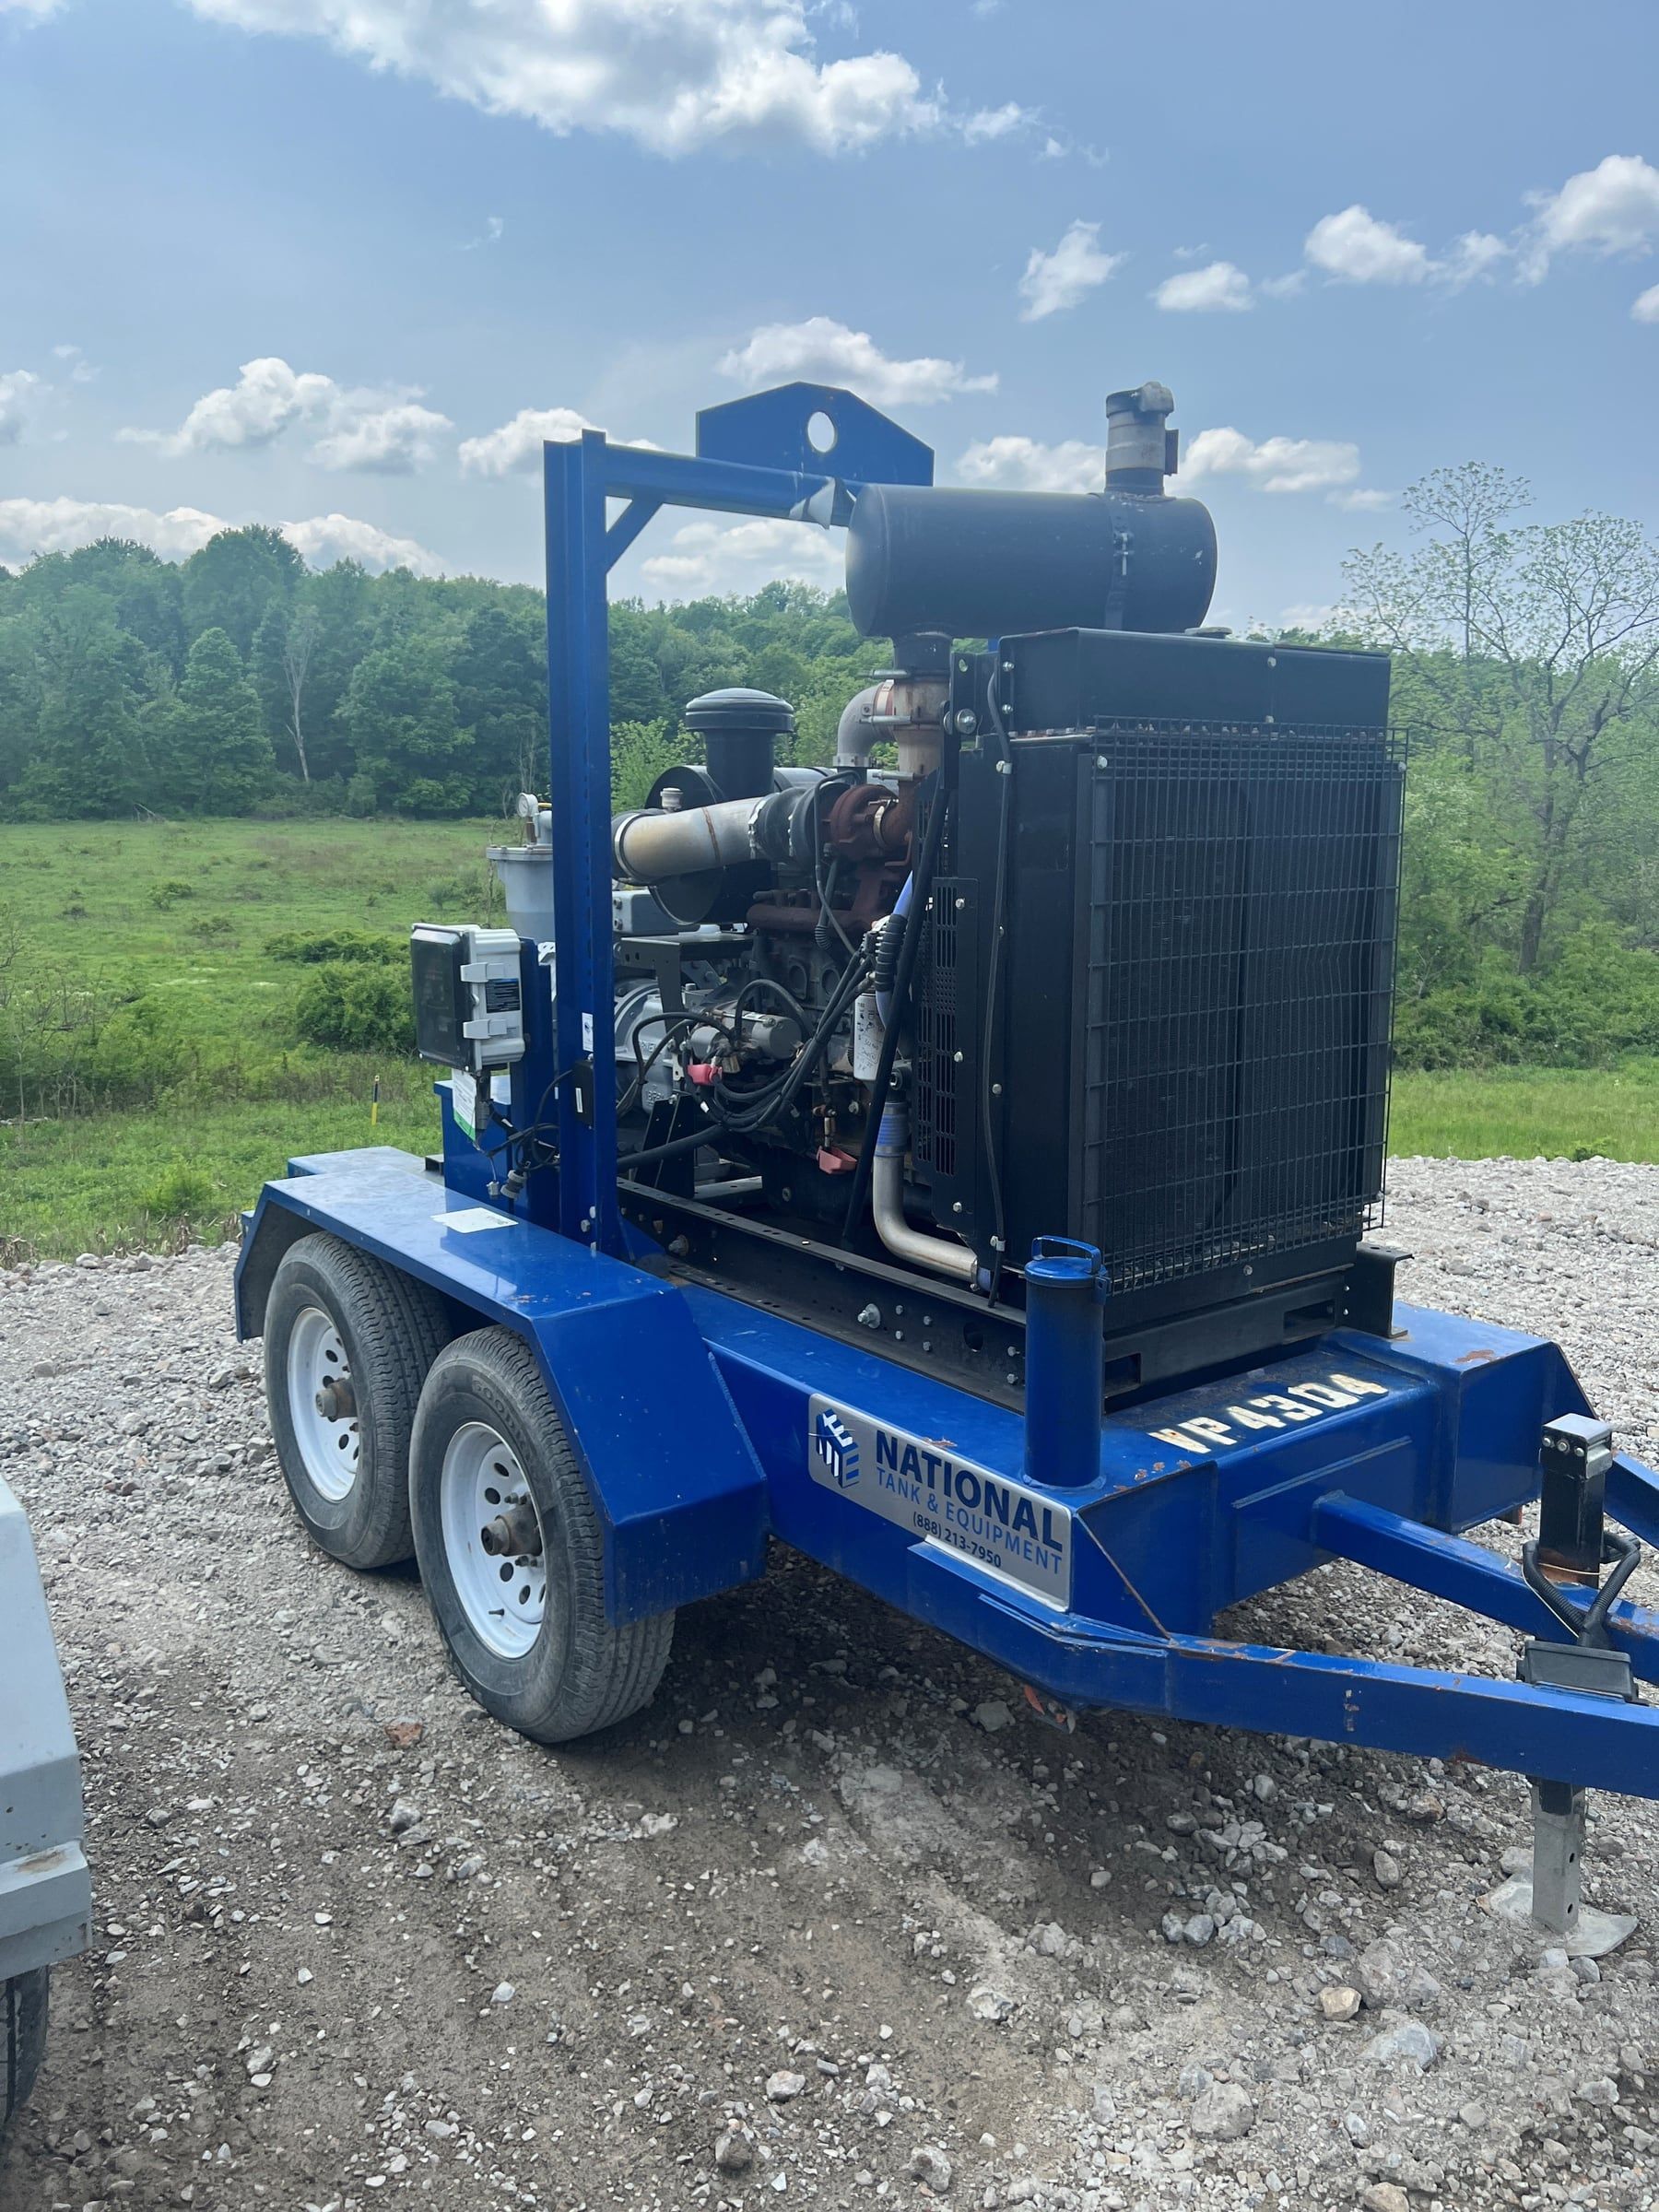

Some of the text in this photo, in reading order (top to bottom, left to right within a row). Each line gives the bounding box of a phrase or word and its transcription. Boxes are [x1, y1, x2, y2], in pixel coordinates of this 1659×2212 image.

[876, 1430, 1063, 1553] NATIONAL
[877, 1466, 1063, 1575] TANK & EQUIPMENT
[913, 1511, 1002, 1568] (888) 213-7950
